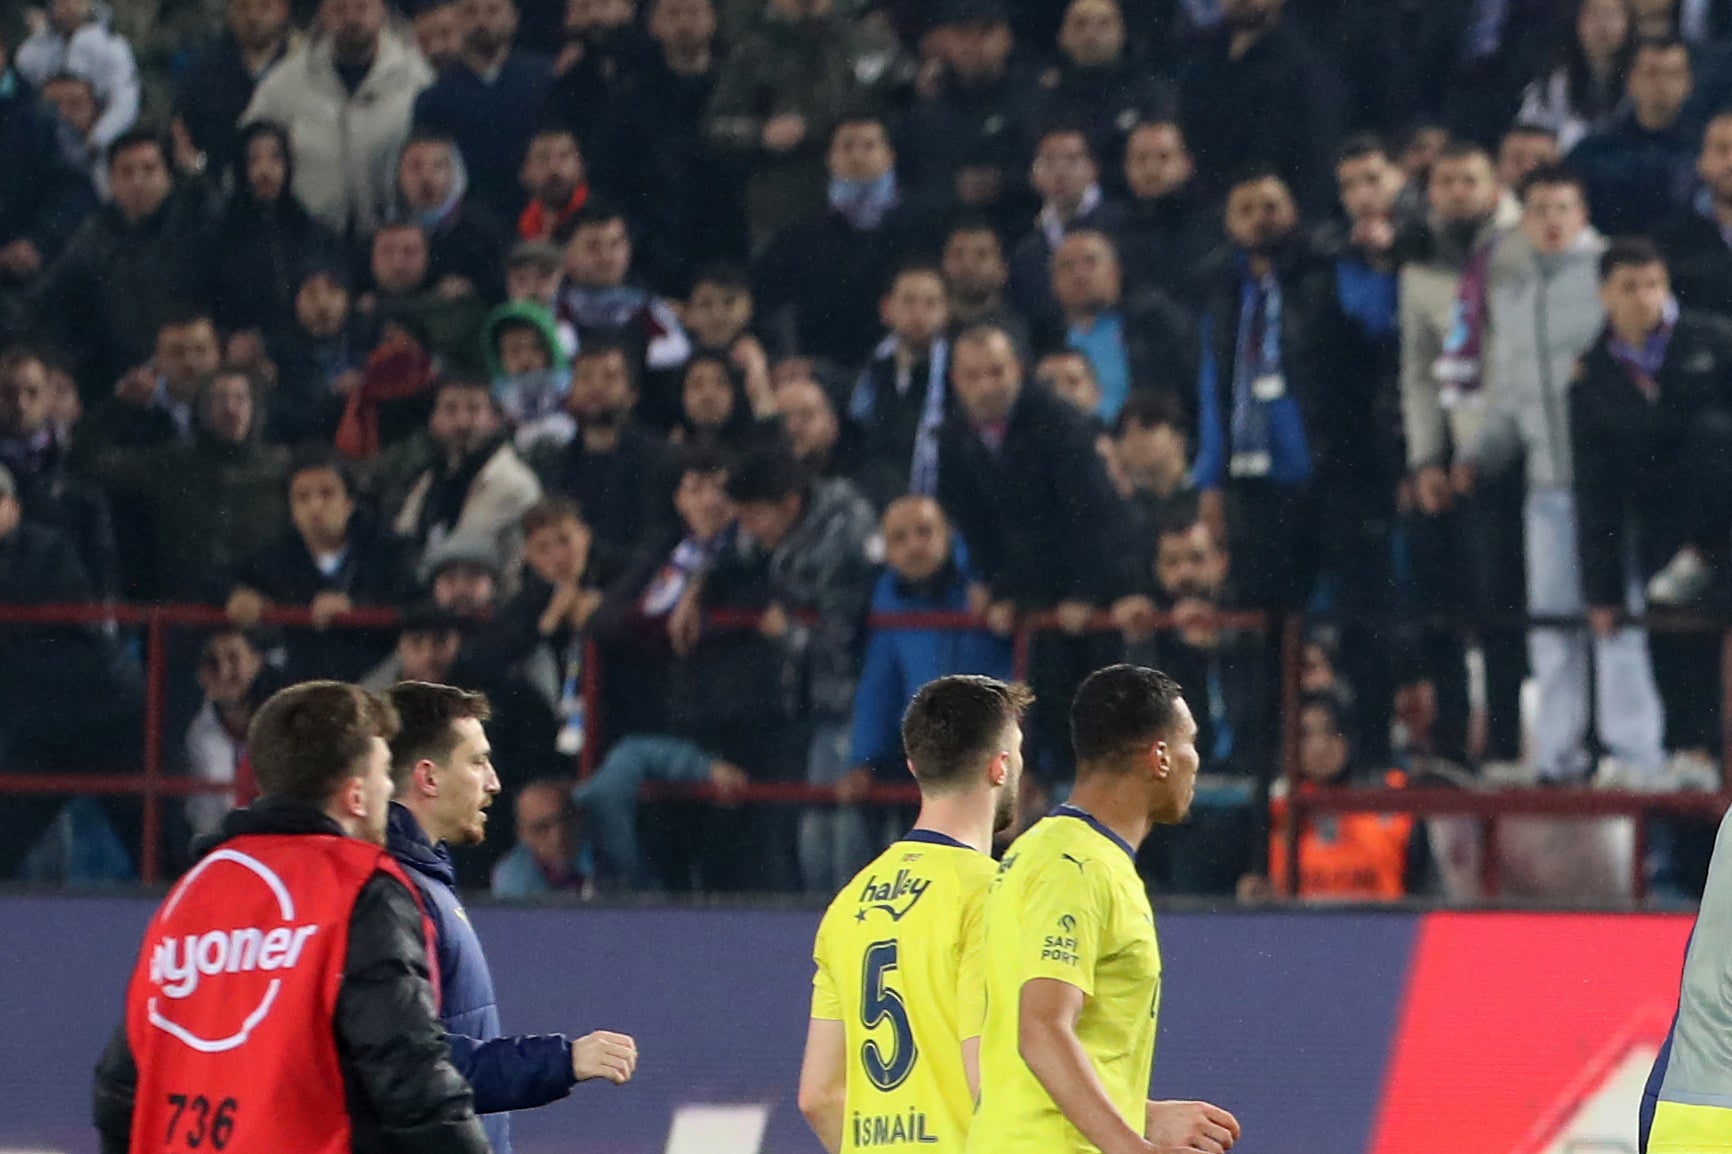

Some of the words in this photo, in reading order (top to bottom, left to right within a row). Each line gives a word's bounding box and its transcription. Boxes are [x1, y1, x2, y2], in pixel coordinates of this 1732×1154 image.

[860, 869, 933, 921] halley
[1041, 949, 1079, 967] PORT
[860, 938, 917, 1092] 5
[165, 1093, 237, 1150] 736
